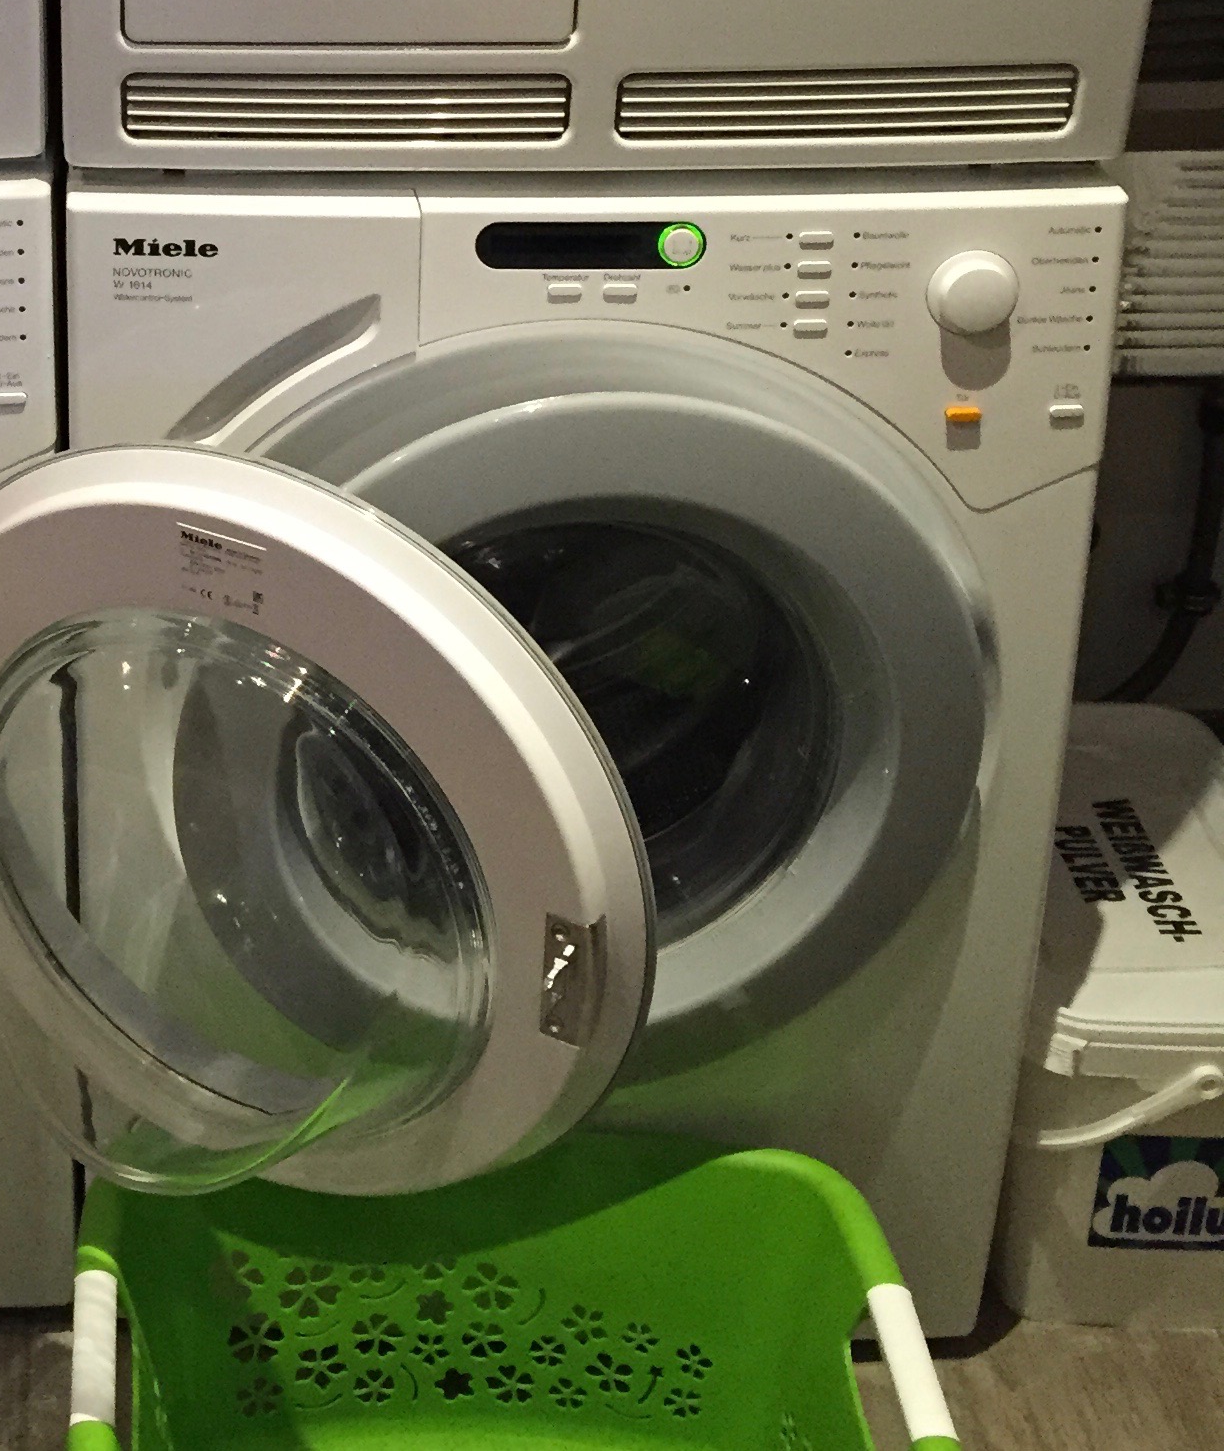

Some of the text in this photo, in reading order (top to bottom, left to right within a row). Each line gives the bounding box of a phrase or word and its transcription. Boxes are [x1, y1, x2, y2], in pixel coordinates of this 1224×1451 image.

[730, 234, 751, 242] Kurz
[113, 238, 219, 258] Miele
[113, 268, 193, 279] NOVOTRONIC
[181, 531, 223, 550] Miele
[1053, 825, 1127, 904] PULVER
